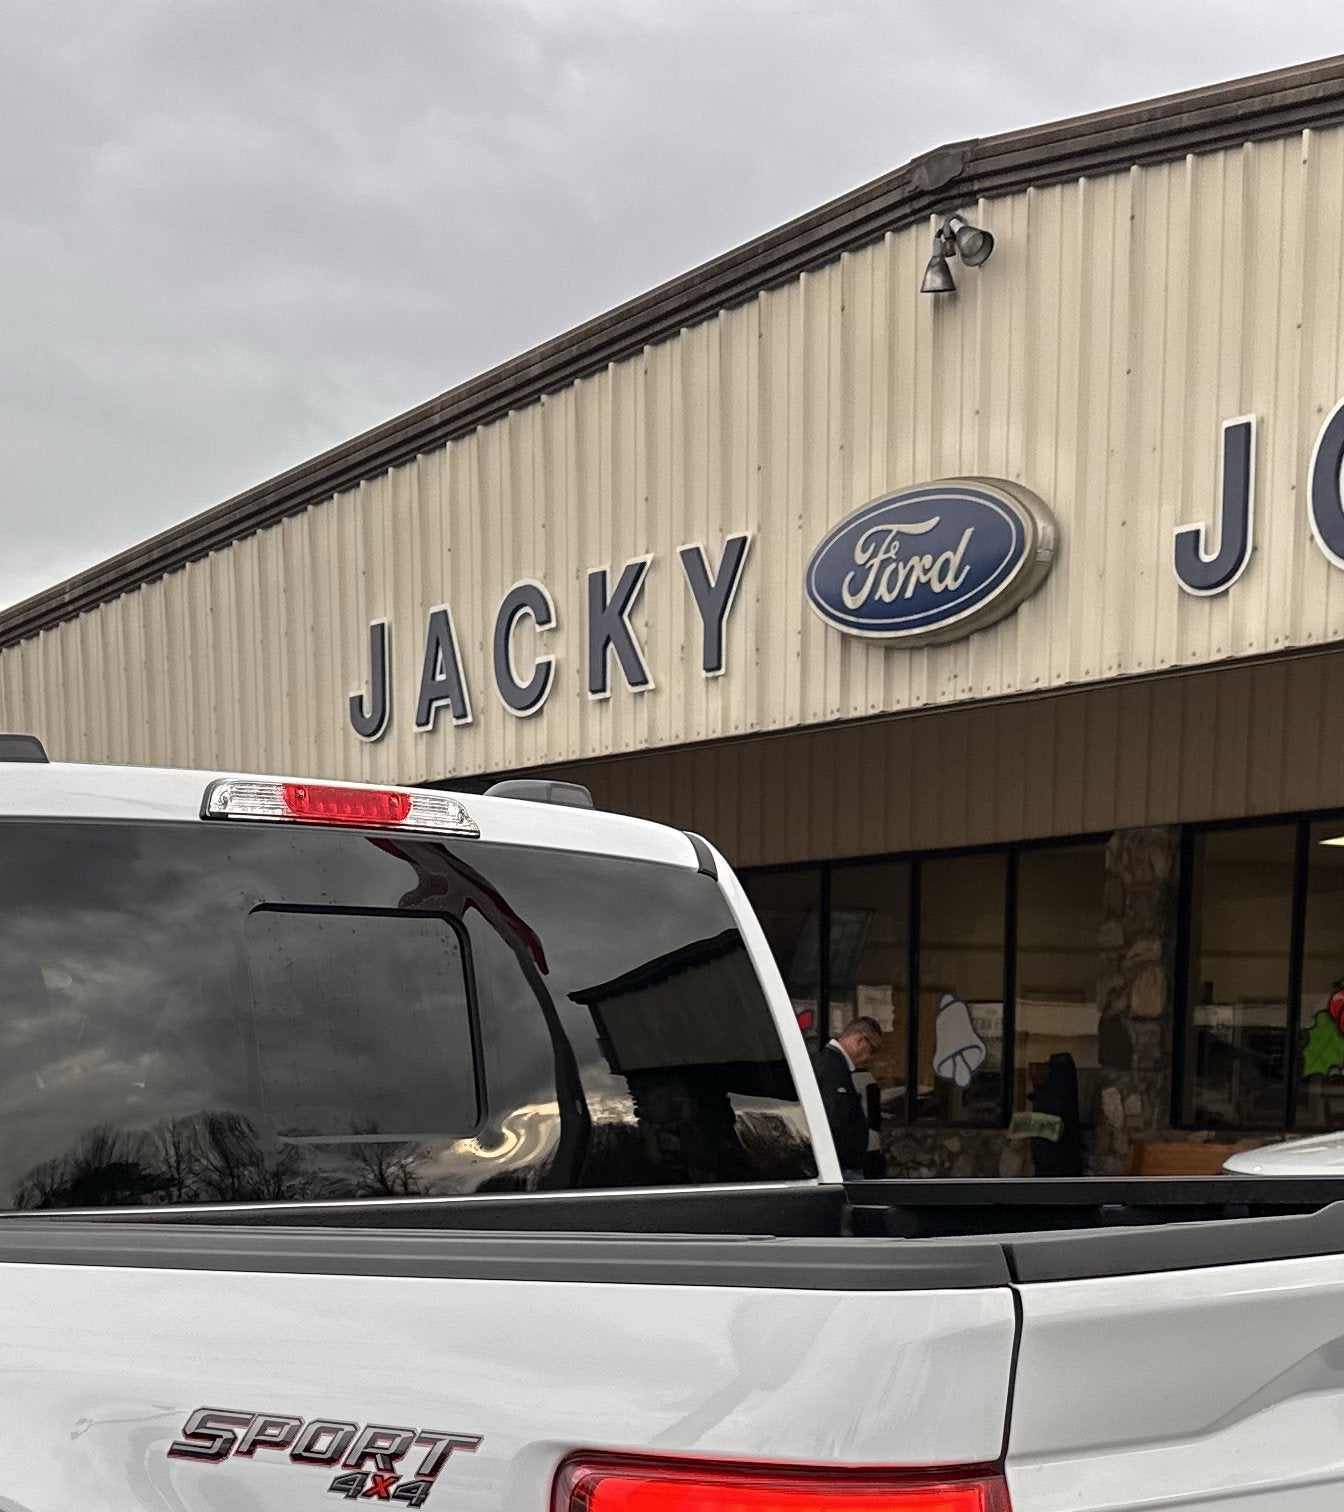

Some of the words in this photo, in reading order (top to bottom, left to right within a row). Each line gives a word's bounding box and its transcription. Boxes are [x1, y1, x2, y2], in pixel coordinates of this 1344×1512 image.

[348, 532, 752, 742] JACKY
[842, 515, 975, 609] Ford
[166, 1405, 484, 1480] SPORT
